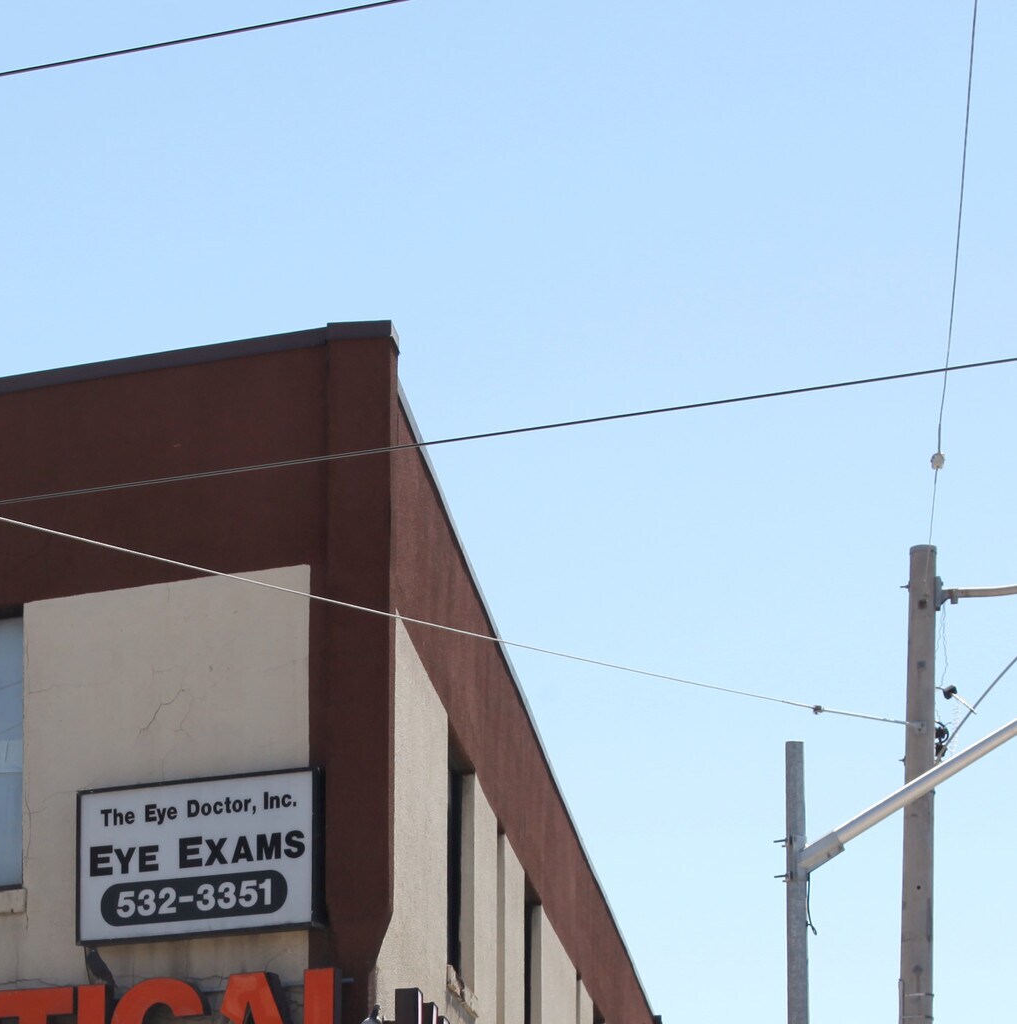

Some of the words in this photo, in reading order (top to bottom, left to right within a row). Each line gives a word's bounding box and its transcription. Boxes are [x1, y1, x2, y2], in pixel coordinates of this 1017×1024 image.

[100, 808, 136, 827] The
[144, 803, 178, 825] Eye
[187, 797, 257, 818] Doctor,
[263, 791, 297, 811] Inc.
[89, 844, 159, 877] EYE
[179, 829, 306, 869] EXAMS
[116, 878, 273, 919] 532-3351
